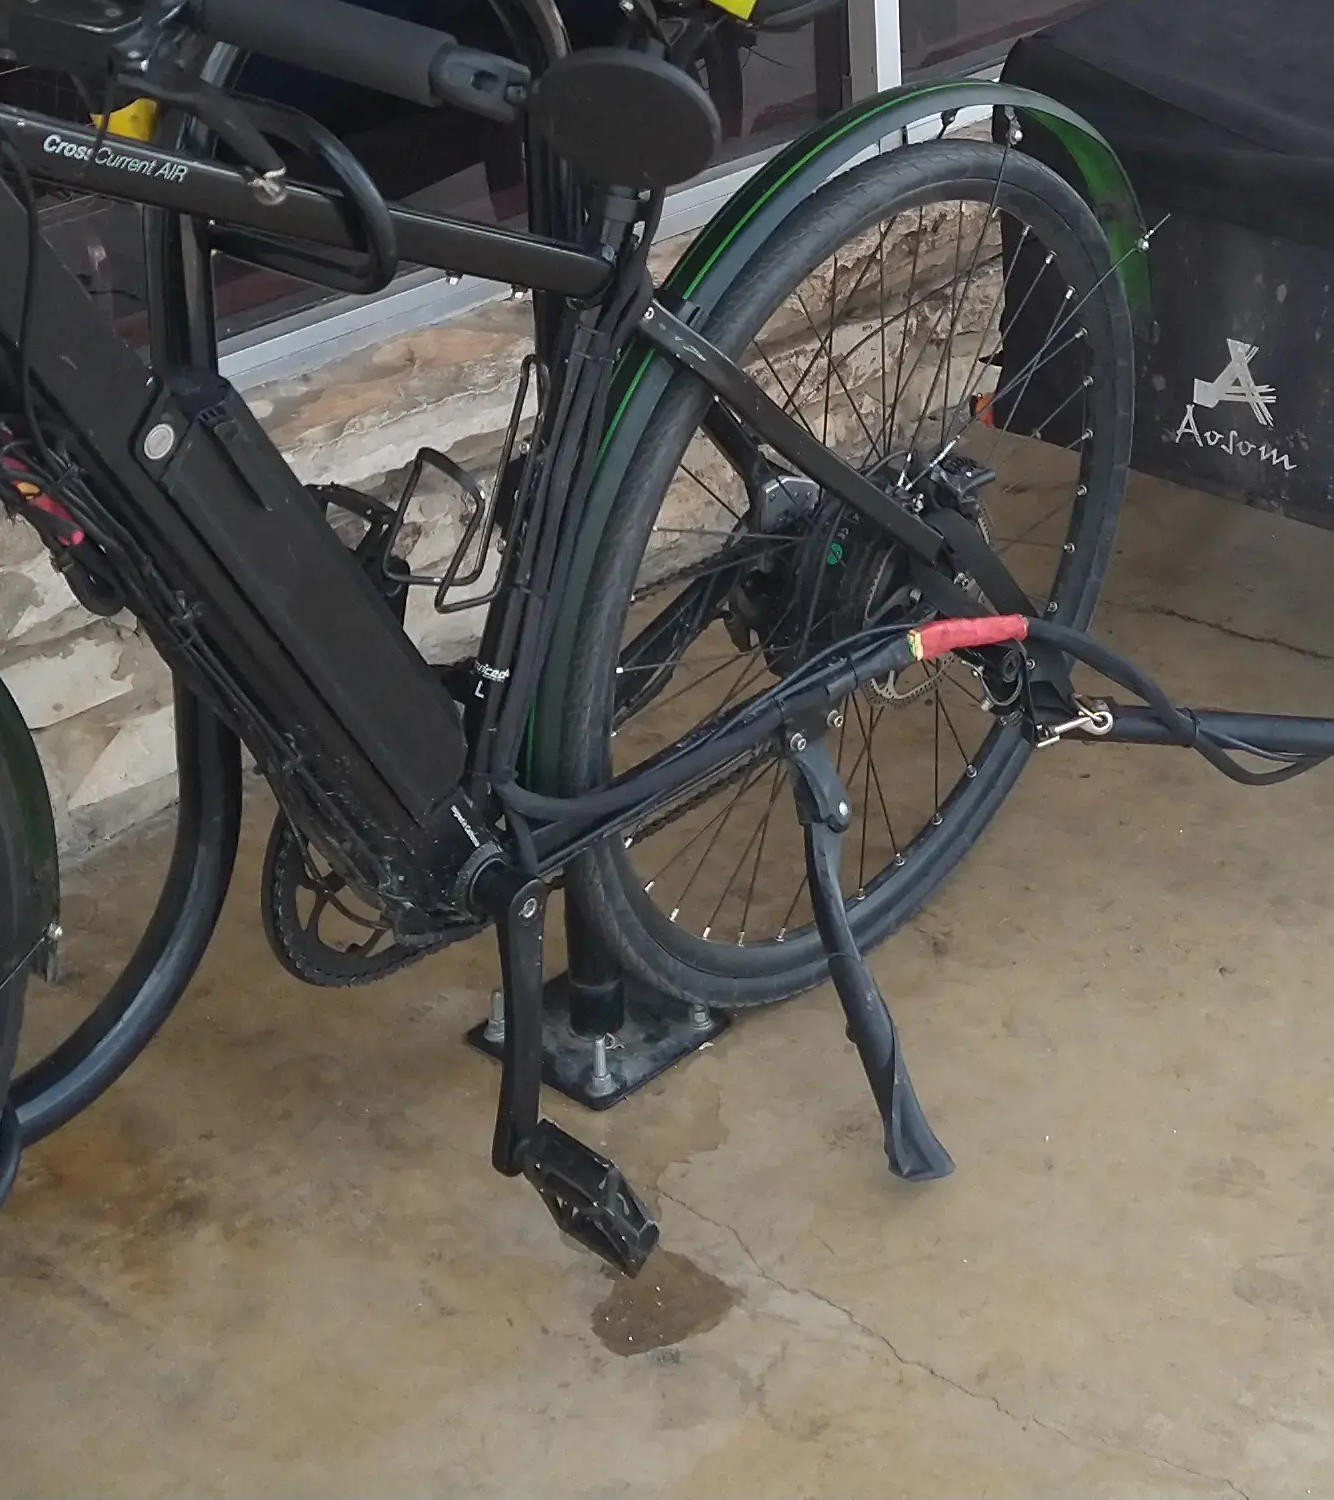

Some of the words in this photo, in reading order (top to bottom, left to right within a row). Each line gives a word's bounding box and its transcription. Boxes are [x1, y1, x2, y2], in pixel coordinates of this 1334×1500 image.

[95, 147, 156, 176] Current
[154, 162, 188, 183] AIR
[1175, 403, 1298, 471] Aosom
[474, 680, 485, 699] L
